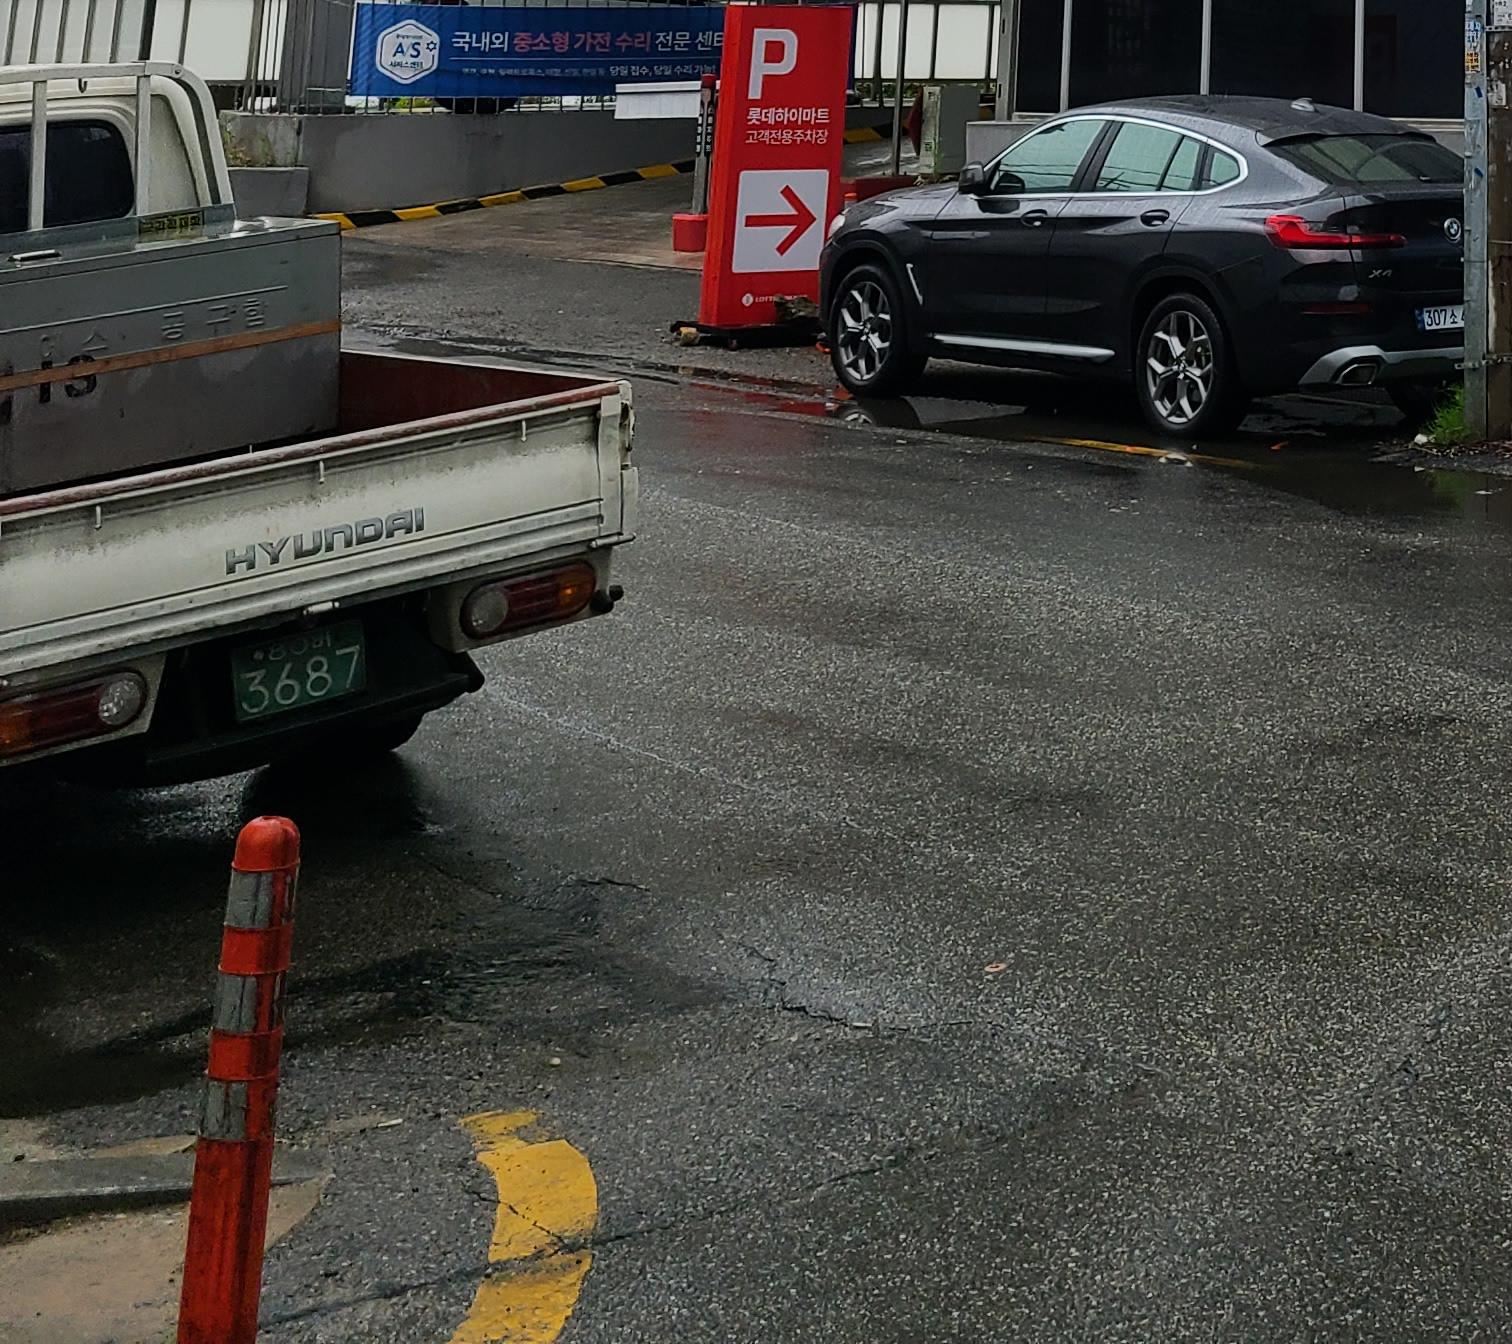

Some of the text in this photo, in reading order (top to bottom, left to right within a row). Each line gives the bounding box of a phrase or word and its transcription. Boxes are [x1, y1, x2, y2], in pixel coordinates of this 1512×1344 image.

[451, 31, 509, 53] 국내외
[513, 31, 570, 53] 중소형
[574, 31, 611, 53] 가전
[615, 31, 651, 53] 수리
[655, 31, 691, 52] 전문
[747, 28, 799, 100] P
[745, 129, 829, 145] 고객전용주차장
[746, 106, 830, 126] 롯데하이마트
[226, 506, 425, 575] HYUNDAI
[239, 644, 361, 714] 3687
